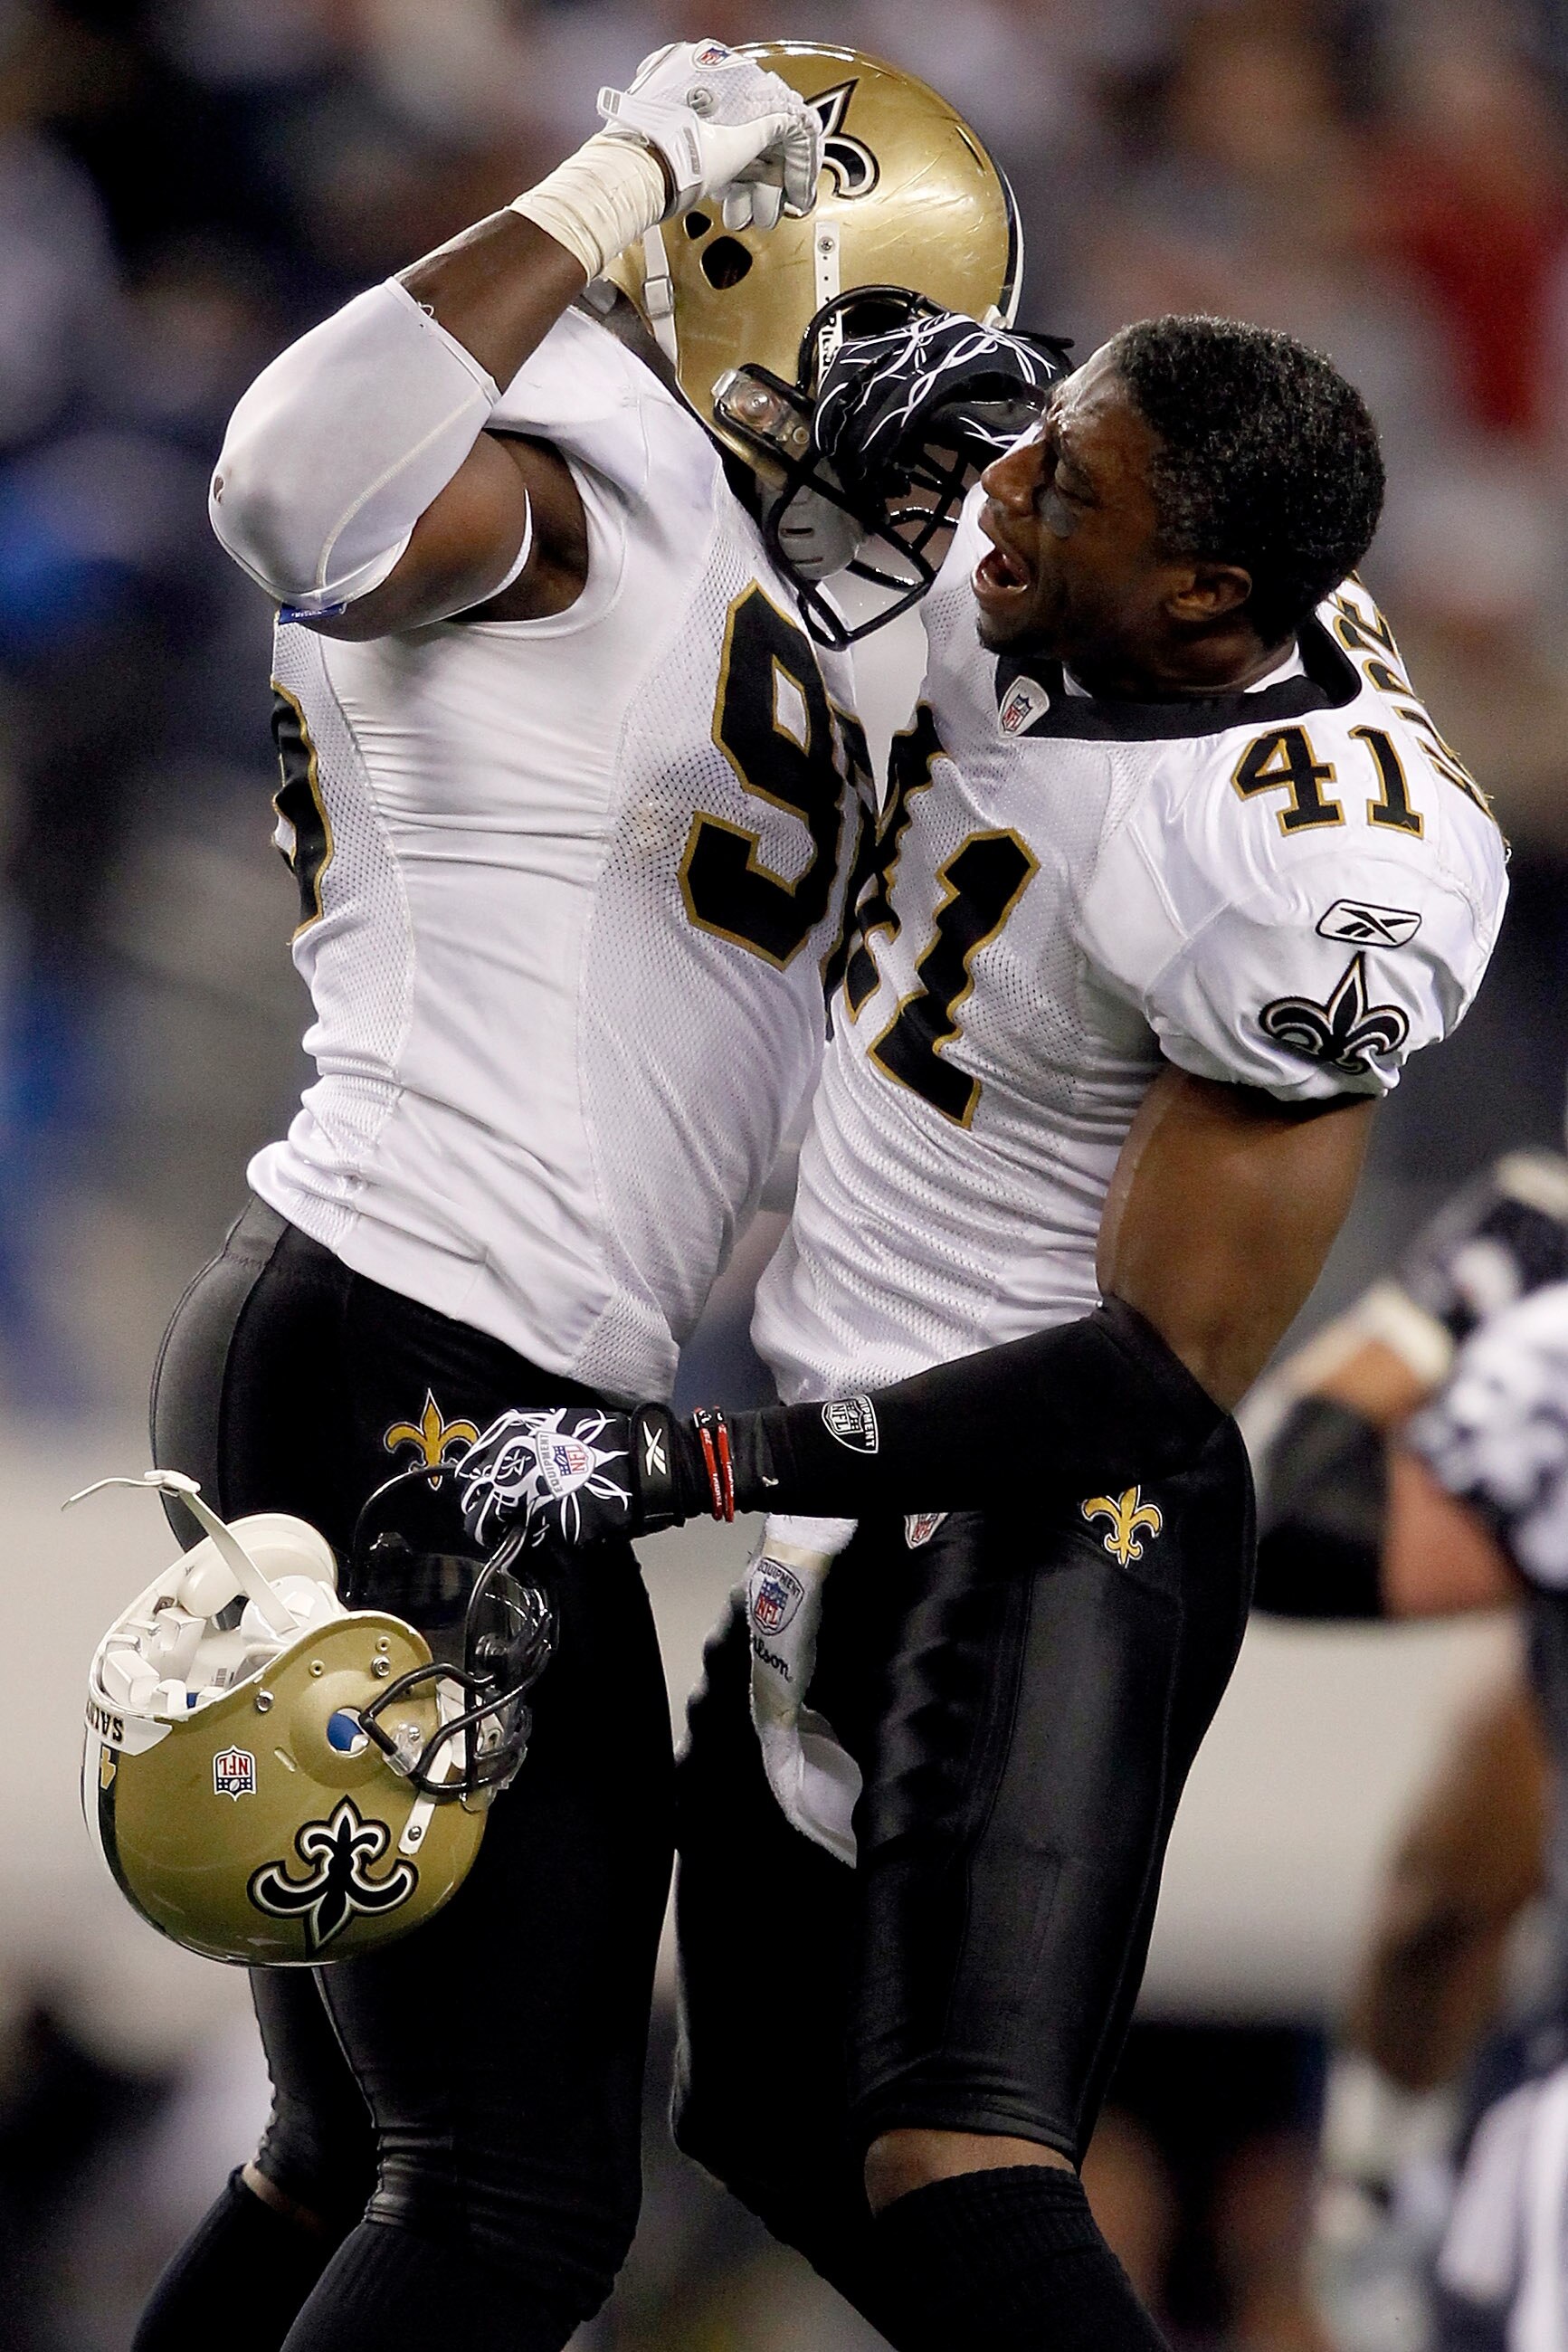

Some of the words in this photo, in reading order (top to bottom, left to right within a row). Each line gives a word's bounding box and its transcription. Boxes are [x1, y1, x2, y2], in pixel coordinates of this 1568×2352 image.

[1231, 723, 1424, 840] 41
[539, 1433, 564, 1493] EQUIPMENT
[566, 1444, 586, 1472] NFL
[755, 1595, 782, 1626] NFL
[752, 1634, 794, 1683] ilson
[218, 1755, 250, 1776] NFL
